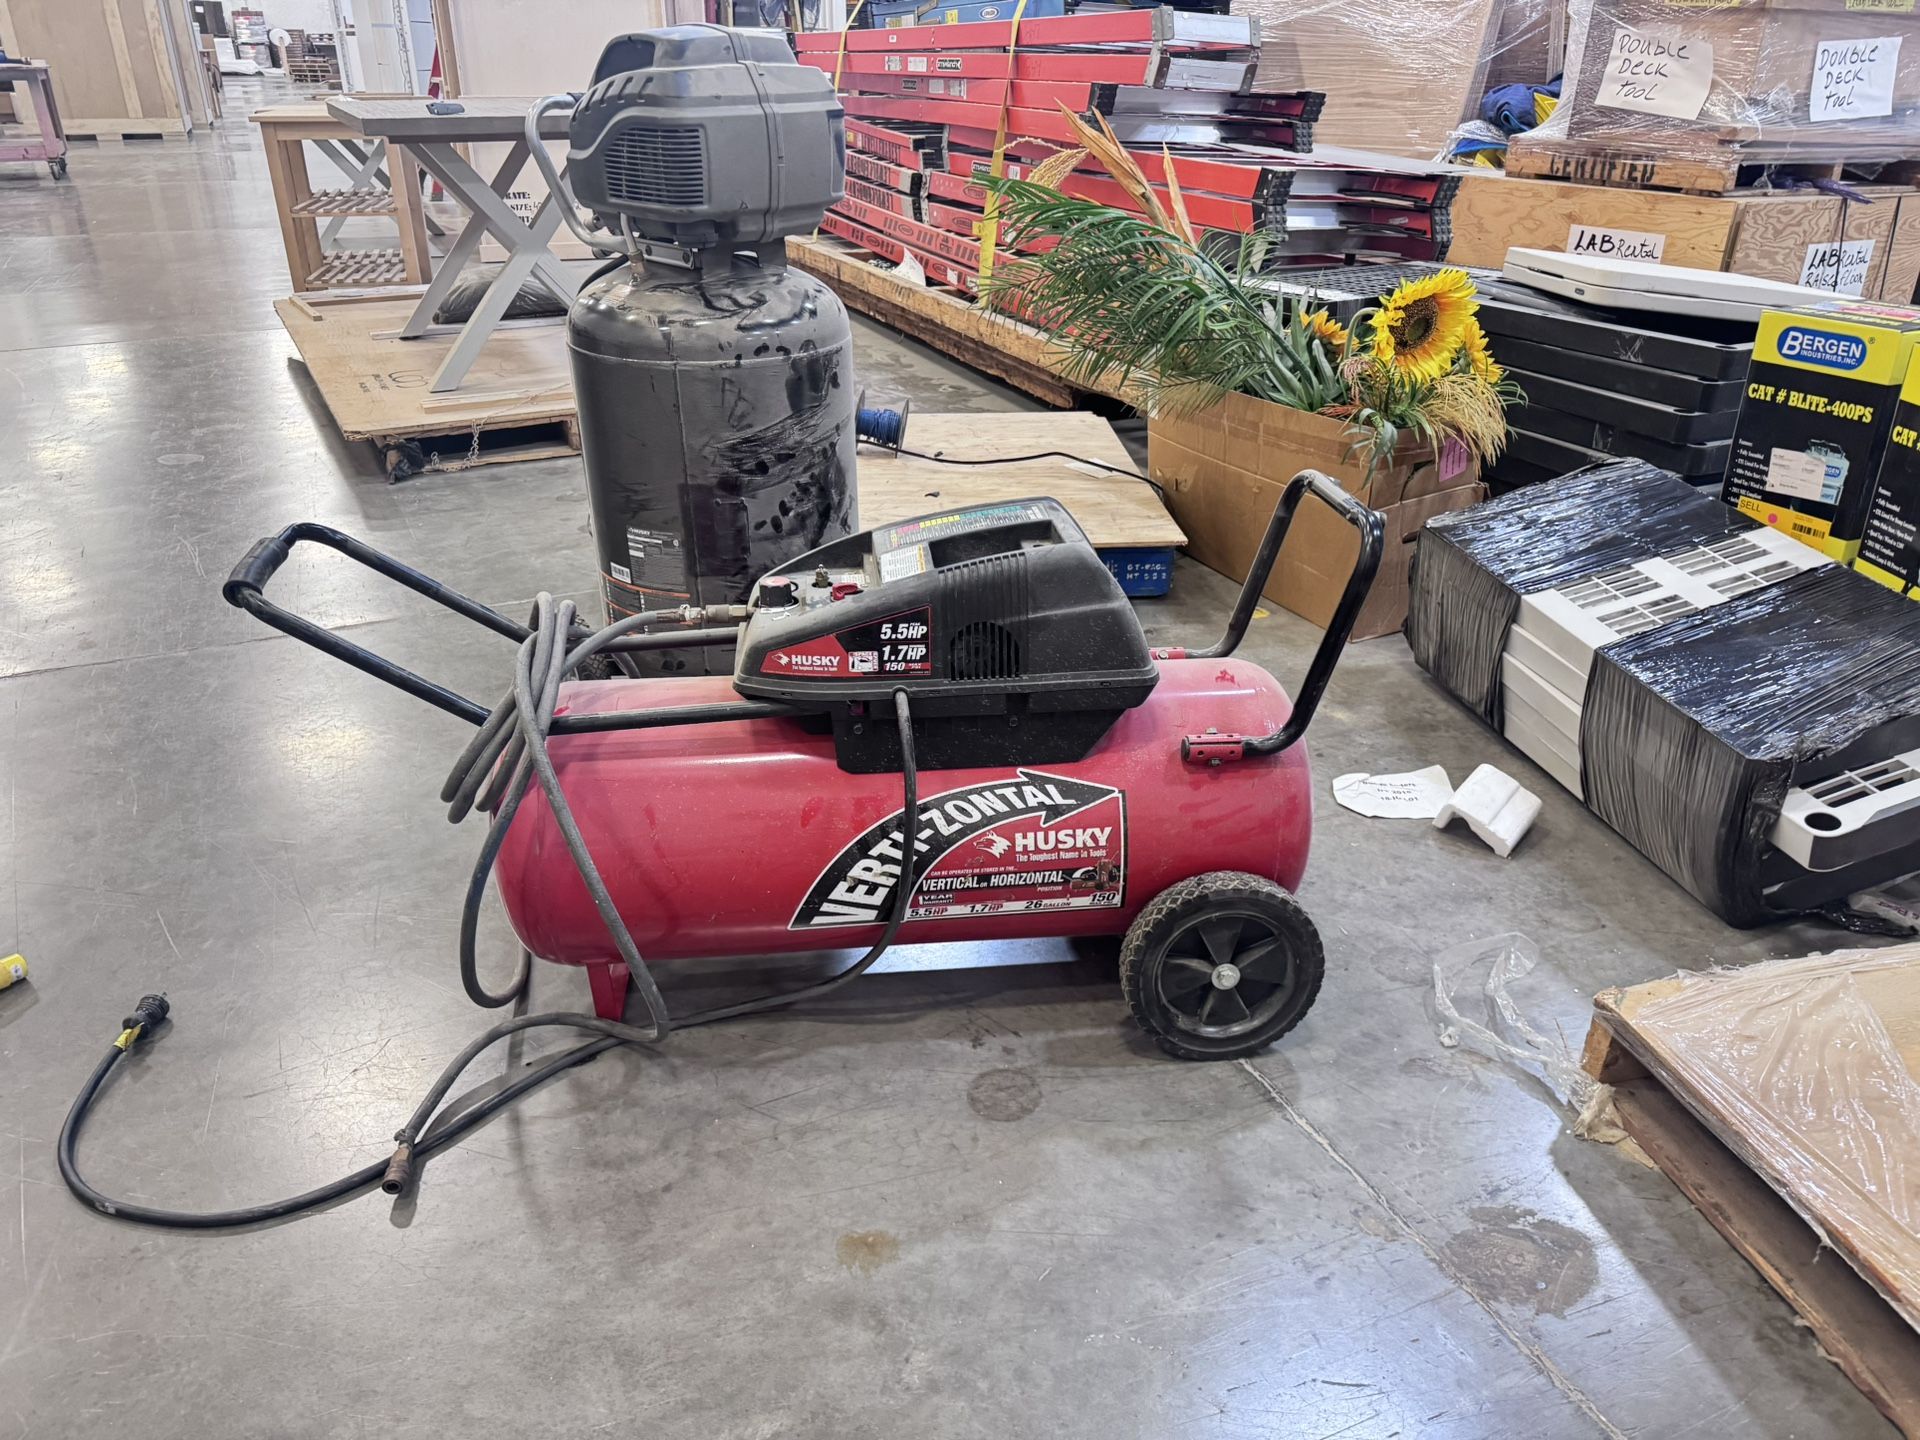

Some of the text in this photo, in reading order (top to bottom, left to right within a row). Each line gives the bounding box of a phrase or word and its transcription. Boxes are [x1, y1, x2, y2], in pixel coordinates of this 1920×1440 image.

[1574, 230, 1616, 253] LAB
[1782, 331, 1862, 358] BERGEN
[1748, 383, 1874, 424] CAT # BLITE-400PS
[1892, 426, 1918, 448] CAT
[1740, 500, 1761, 513] SELL
[880, 624, 928, 640] 5.5HP
[792, 655, 840, 666] HUSKY
[882, 645, 926, 661] 1.7HP
[884, 662, 906, 671] 150
[1015, 827, 1112, 852] HUSKY
[1016, 854, 1028, 862] The
[1030, 852, 1058, 862] Toughest
[1060, 850, 1079, 860] Name
[1089, 848, 1107, 858] Tools
[922, 876, 980, 892] VERTICAL
[990, 870, 1064, 887] HORIZONTAL
[1025, 900, 1042, 909] 26
[1091, 892, 1117, 902] 150
